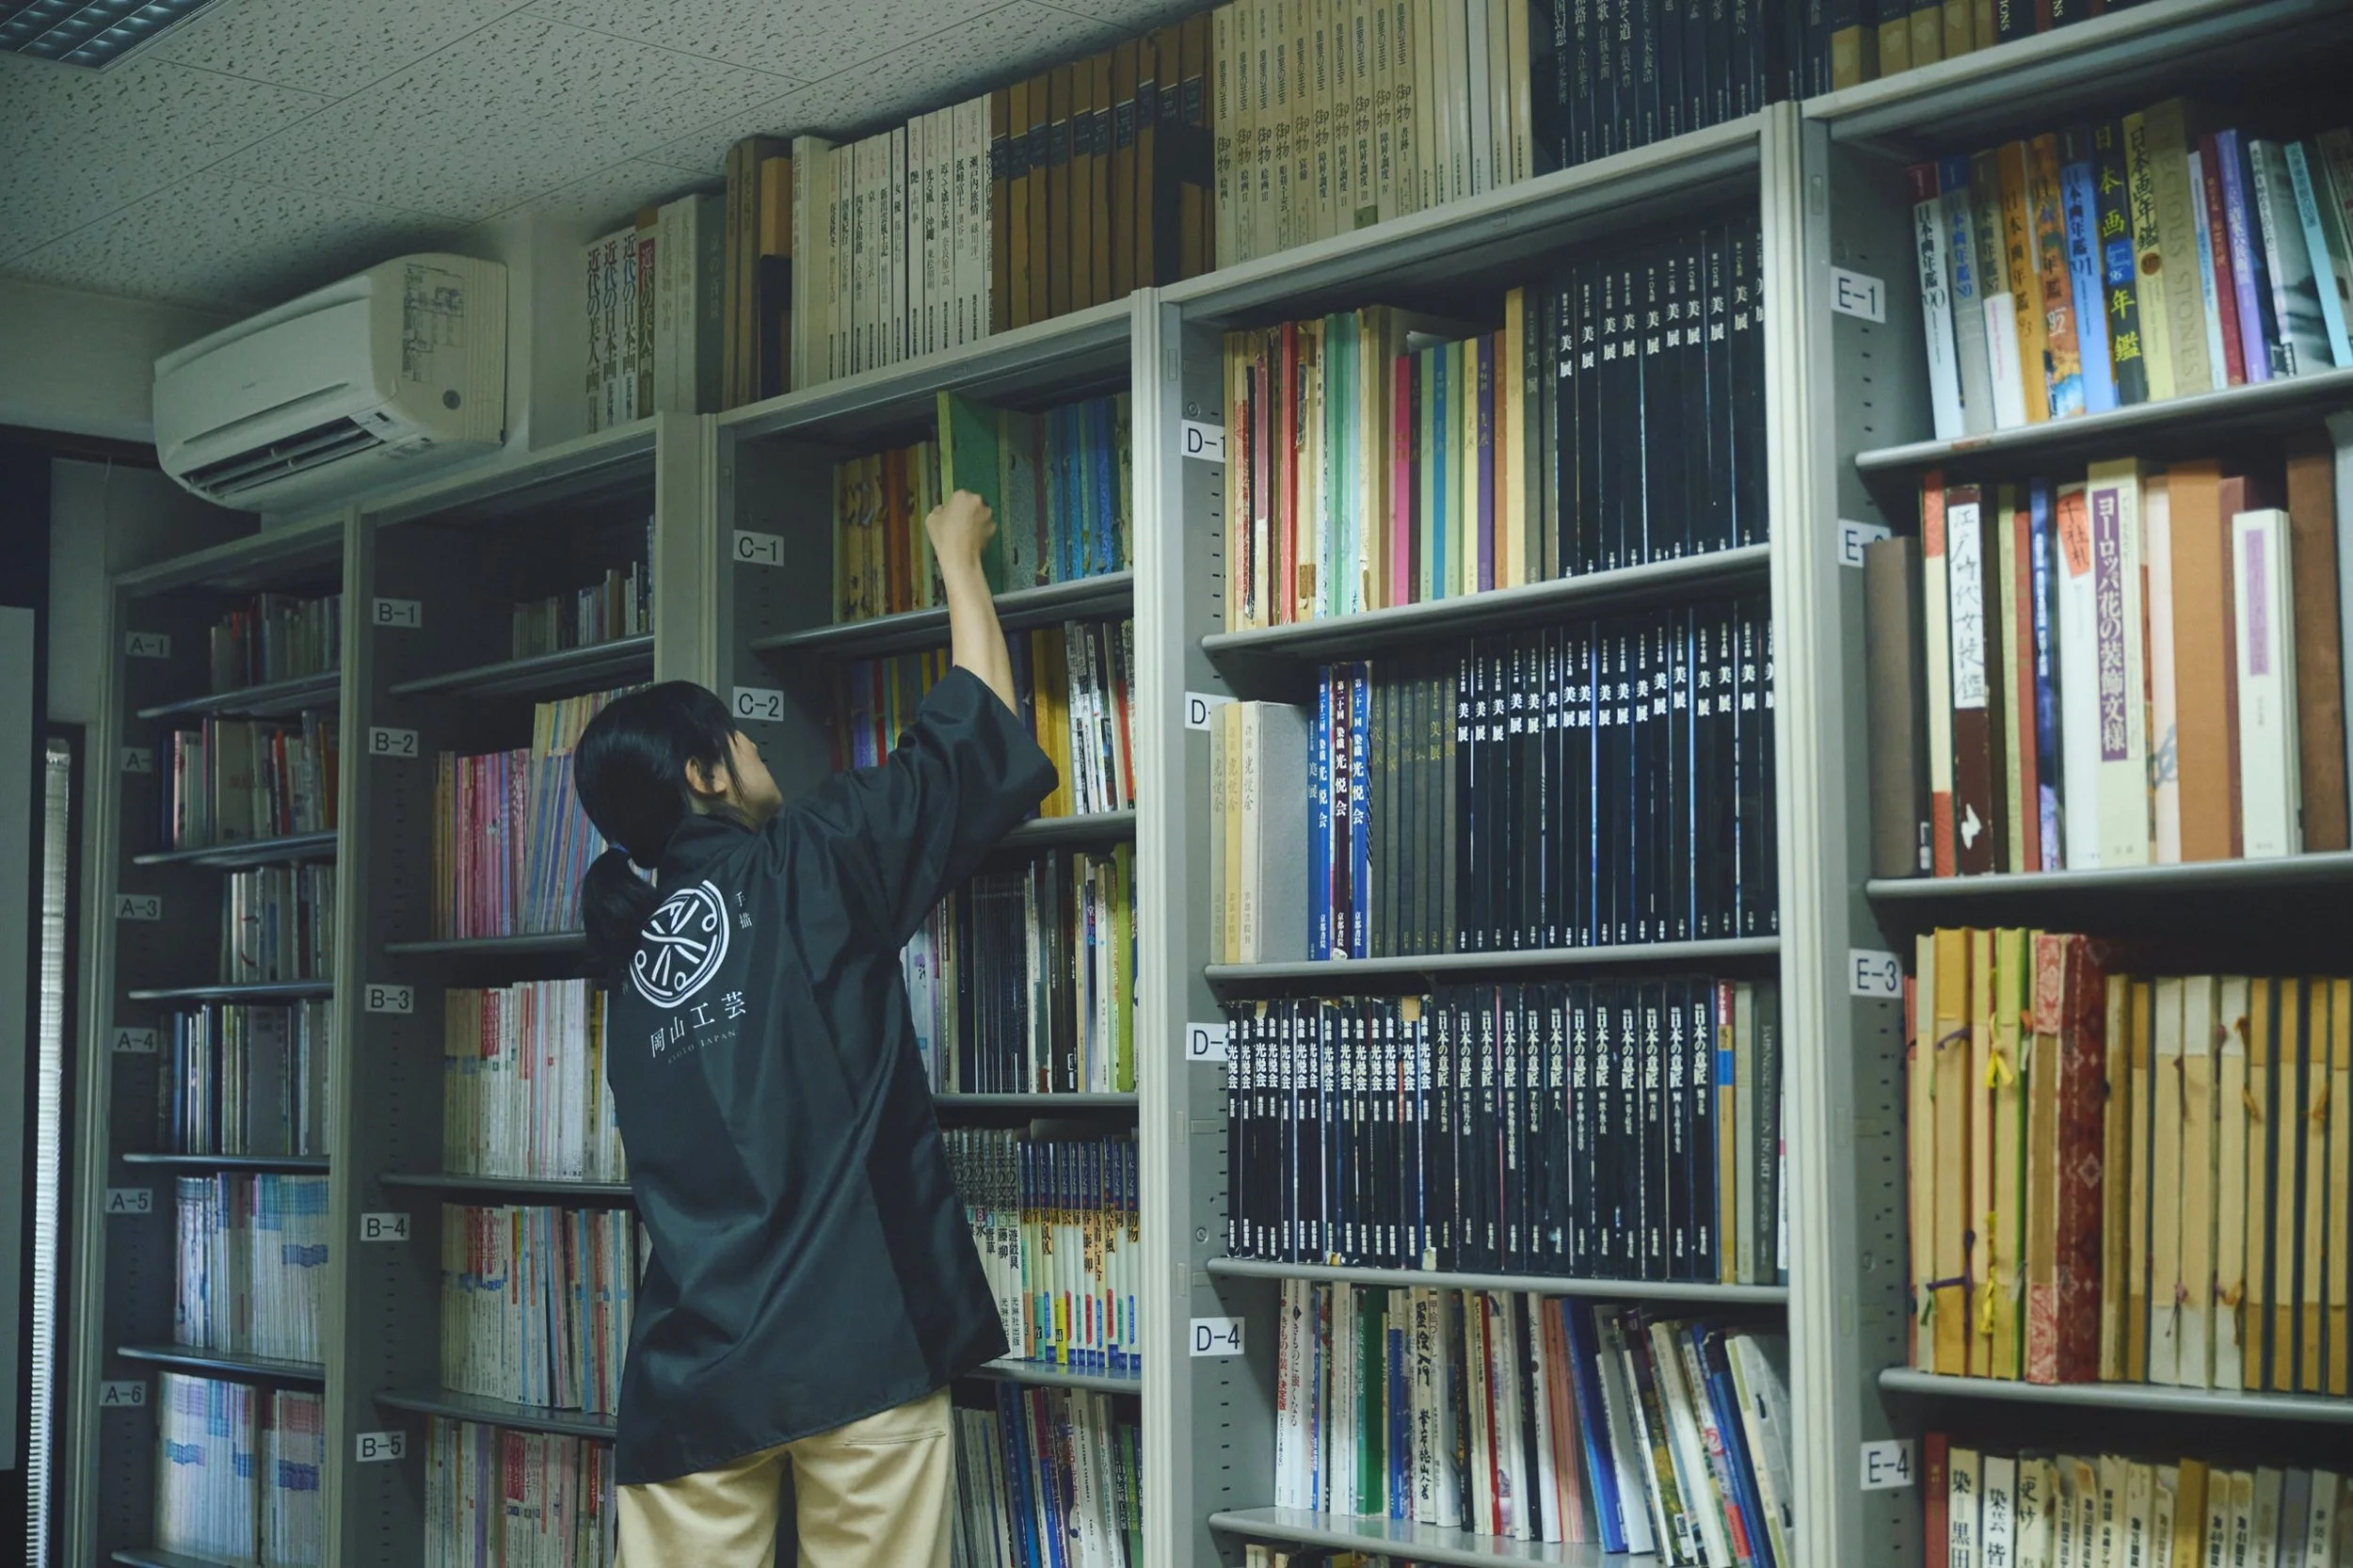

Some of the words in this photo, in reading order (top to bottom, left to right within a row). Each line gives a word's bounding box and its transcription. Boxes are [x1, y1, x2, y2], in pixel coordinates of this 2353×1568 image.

[2130, 126, 2160, 252] 日本画年鑑
[603, 239, 617, 383] 近代の日本画
[623, 232, 636, 376] 近代の日本画
[640, 247, 655, 376] 近代の美人画
[1710, 296, 1724, 342] 美展
[1734, 285, 1749, 331] 美展
[1838, 280, 1876, 314] E-1
[585, 247, 600, 395] 近代の美人画
[1603, 316, 1617, 360] 美展
[1623, 313, 1636, 358] 美展
[1646, 311, 1659, 356] 美展
[1666, 302, 1680, 347] 美展
[1687, 300, 1701, 345] 美展
[1560, 334, 1573, 377] 美展
[1581, 326, 1594, 369] 美展
[1188, 428, 1225, 458] D-1
[739, 537, 777, 562] C-1
[378, 604, 415, 623] B-1
[2098, 496, 2126, 753] ヨーロッパ花の装飾文様
[132, 636, 164, 654] A-1
[739, 694, 778, 717] C-2
[1337, 680, 1345, 720] 第二十回
[1354, 679, 1363, 728] 第二十一回
[1546, 692, 1558, 728] 美展
[1563, 686, 1577, 728] 美展
[1578, 685, 1592, 728] 美展
[1599, 684, 1611, 727] 美展
[1617, 682, 1629, 725] 美展
[1636, 680, 1648, 723] 美展
[1654, 672, 1667, 715] 美展
[1673, 666, 1687, 710] 美展
[1697, 670, 1710, 717] 美展
[1719, 665, 1732, 712] 美展
[1741, 664, 1756, 711] 美展
[1458, 702, 1469, 743] 美展
[1475, 701, 1486, 741] 美展
[1492, 698, 1505, 742] 美展
[1510, 693, 1523, 734] 美展
[1528, 693, 1540, 734] 美展
[127, 753, 152, 769] A-
[376, 733, 414, 751] B-2
[1336, 727, 1346, 750] 染織
[1353, 734, 1363, 757] 染織
[1431, 720, 1441, 760] 美展
[1335, 754, 1348, 817] 光悦会
[1353, 761, 1365, 824] 光悦会
[121, 899, 157, 917] A-3
[734, 890, 753, 930] 手描
[1857, 959, 1897, 991] E-3
[371, 990, 409, 1009] B-3
[118, 1032, 153, 1049] A-4
[649, 990, 747, 1059] 岡山工芸
[700, 1029, 737, 1048] JAPAN
[1227, 1044, 1238, 1089] 光悦会
[1241, 1044, 1251, 1089] 光悦会
[1255, 1043, 1267, 1088] 光悦会
[1268, 1043, 1278, 1088] 光悦会
[1281, 1044, 1291, 1090] 光悦会
[1296, 1043, 1307, 1090] 光悦会
[1309, 1042, 1319, 1088] 光悦会
[1324, 1046, 1335, 1092] 光悦会
[1340, 1043, 1352, 1091] 光悦会
[1355, 1044, 1367, 1092] 光悦会
[1370, 1044, 1382, 1092] 光悦会
[1385, 1043, 1396, 1092] 光悦会
[1402, 1044, 1416, 1092] 光悦会
[1419, 1043, 1431, 1090] 光悦会
[1437, 1016, 1449, 1088] 日本の意匠
[1460, 1017, 1472, 1089] 日本の意匠
[1481, 1016, 1494, 1087] 日本の意匠
[1504, 1017, 1516, 1088] 日本の意匠
[1527, 1016, 1539, 1087] 日本の意匠
[1550, 1015, 1562, 1087] 日本の意匠
[1573, 1016, 1586, 1088] 日本の意匠
[1595, 1013, 1609, 1087] 日本の意匠
[1621, 1015, 1635, 1090] 日本の意匠
[1645, 1013, 1658, 1089] 日本の意匠
[1670, 1012, 1683, 1088] 日本の意匠
[1693, 1009, 1707, 1086] 日本の意匠
[111, 1193, 149, 1210] A-5
[366, 1219, 406, 1238] B-4
[1196, 1324, 1240, 1351] D-4
[105, 1384, 142, 1403] A-6
[1290, 1321, 1301, 1427] きものに強くなる
[361, 1437, 401, 1456] B-5
[1868, 1450, 1910, 1482] E-4
[1952, 1470, 1972, 1494] 染
